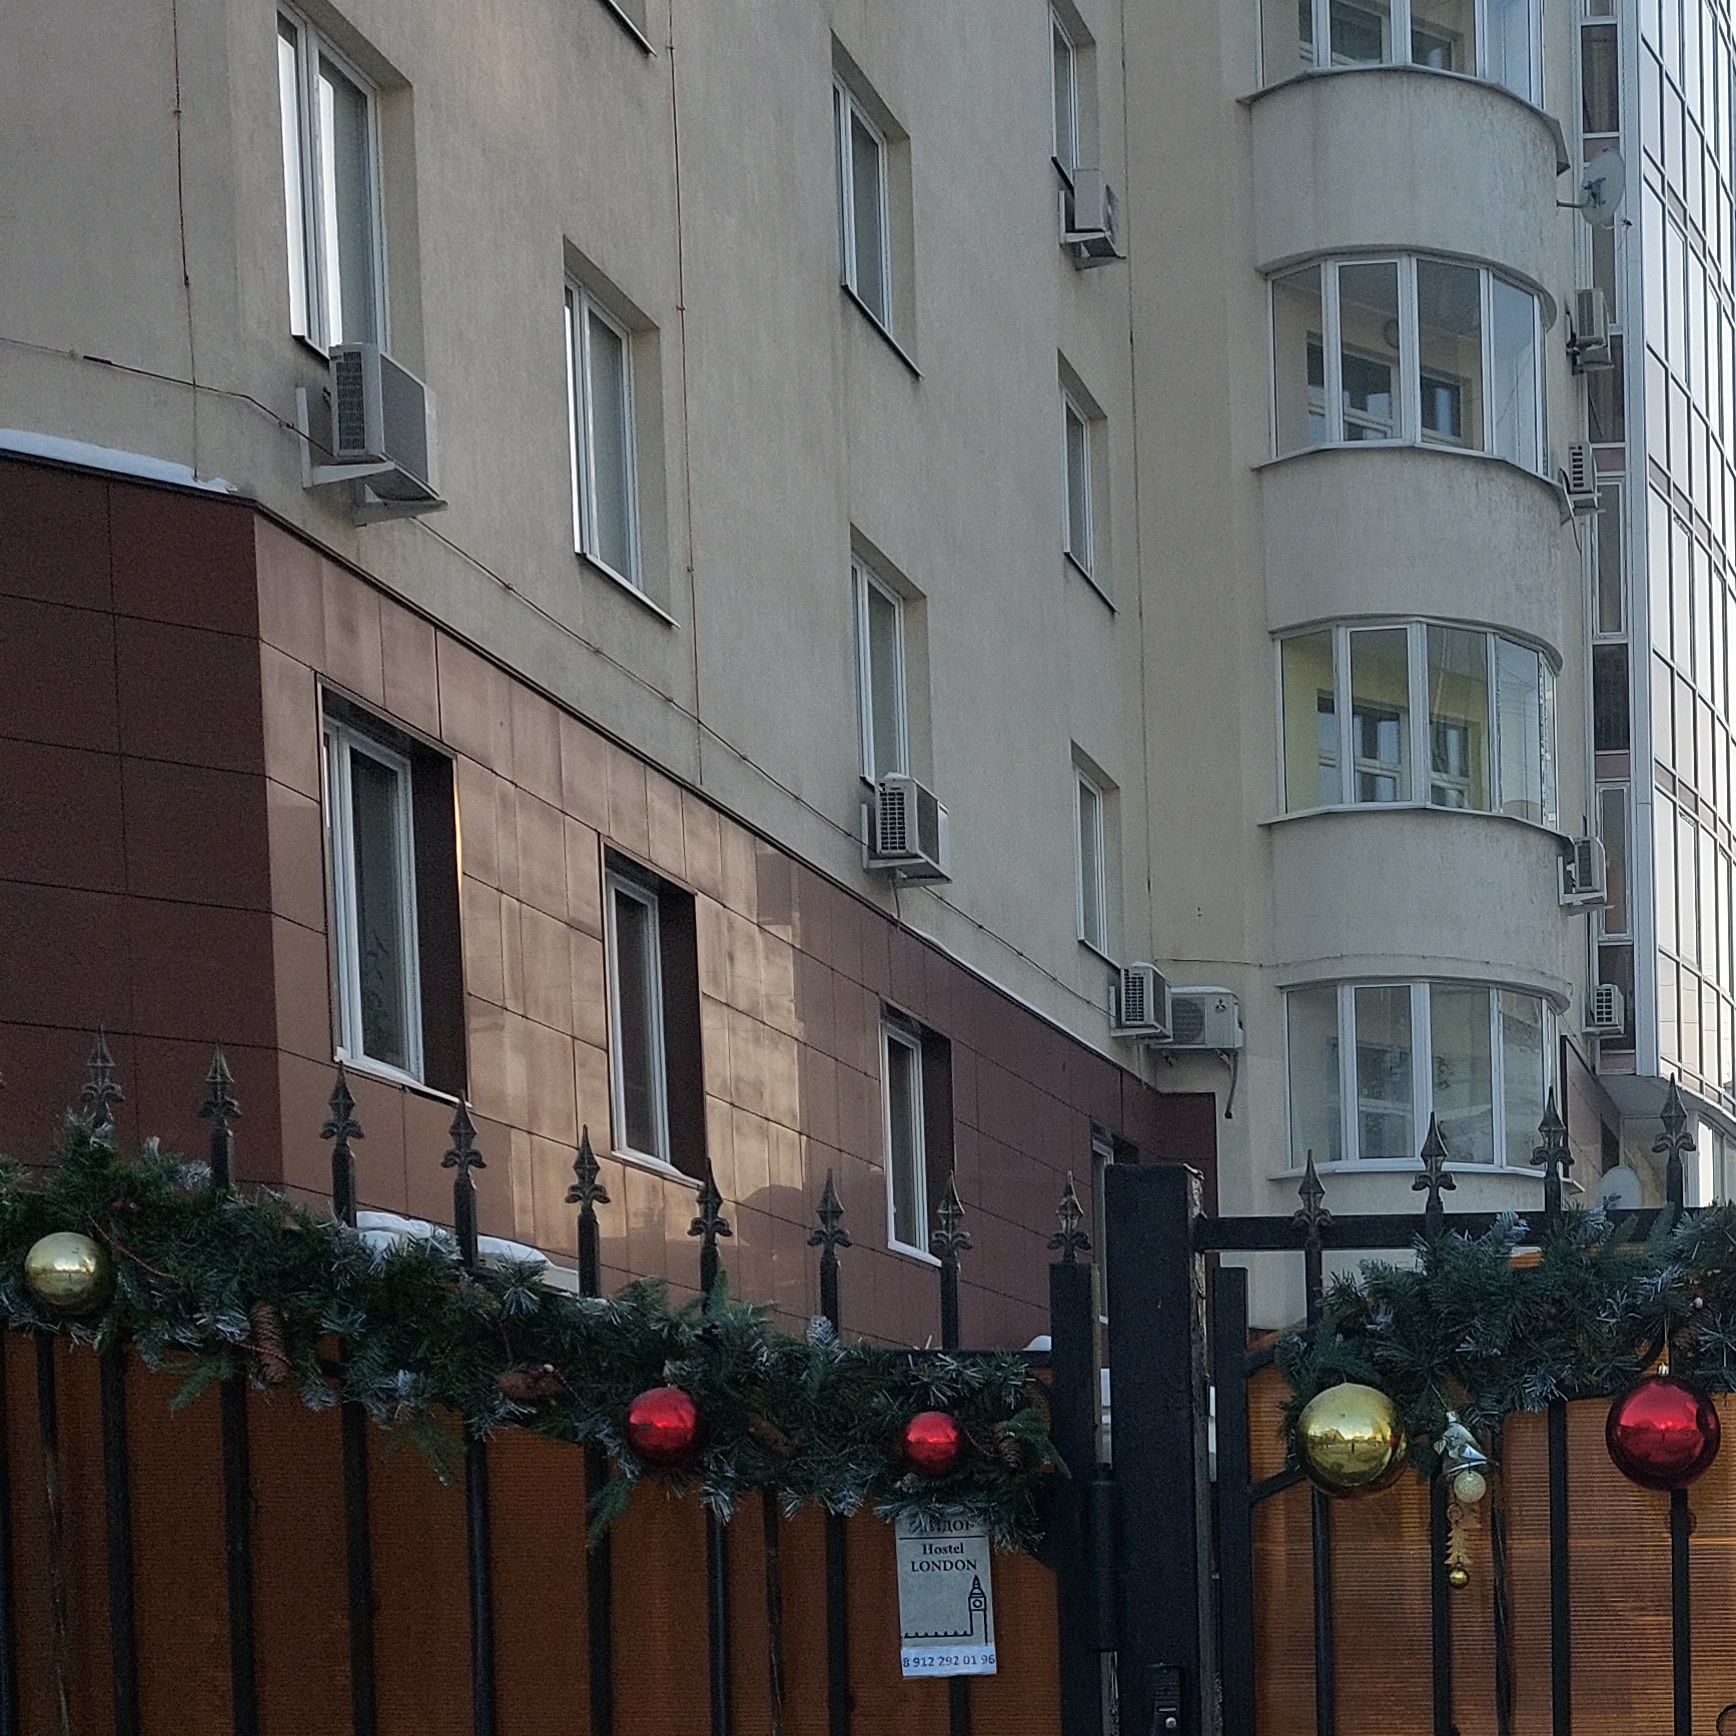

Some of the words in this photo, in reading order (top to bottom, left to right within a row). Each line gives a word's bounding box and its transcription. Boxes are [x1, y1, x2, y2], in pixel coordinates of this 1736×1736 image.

[922, 1542, 965, 1555] Hostel
[911, 1559, 977, 1572] LONDON
[903, 1658, 910, 1668] 8
[913, 1657, 934, 1668] 912
[938, 1656, 959, 1666] 292
[963, 1655, 977, 1665] 01
[981, 1654, 995, 1664] 96
